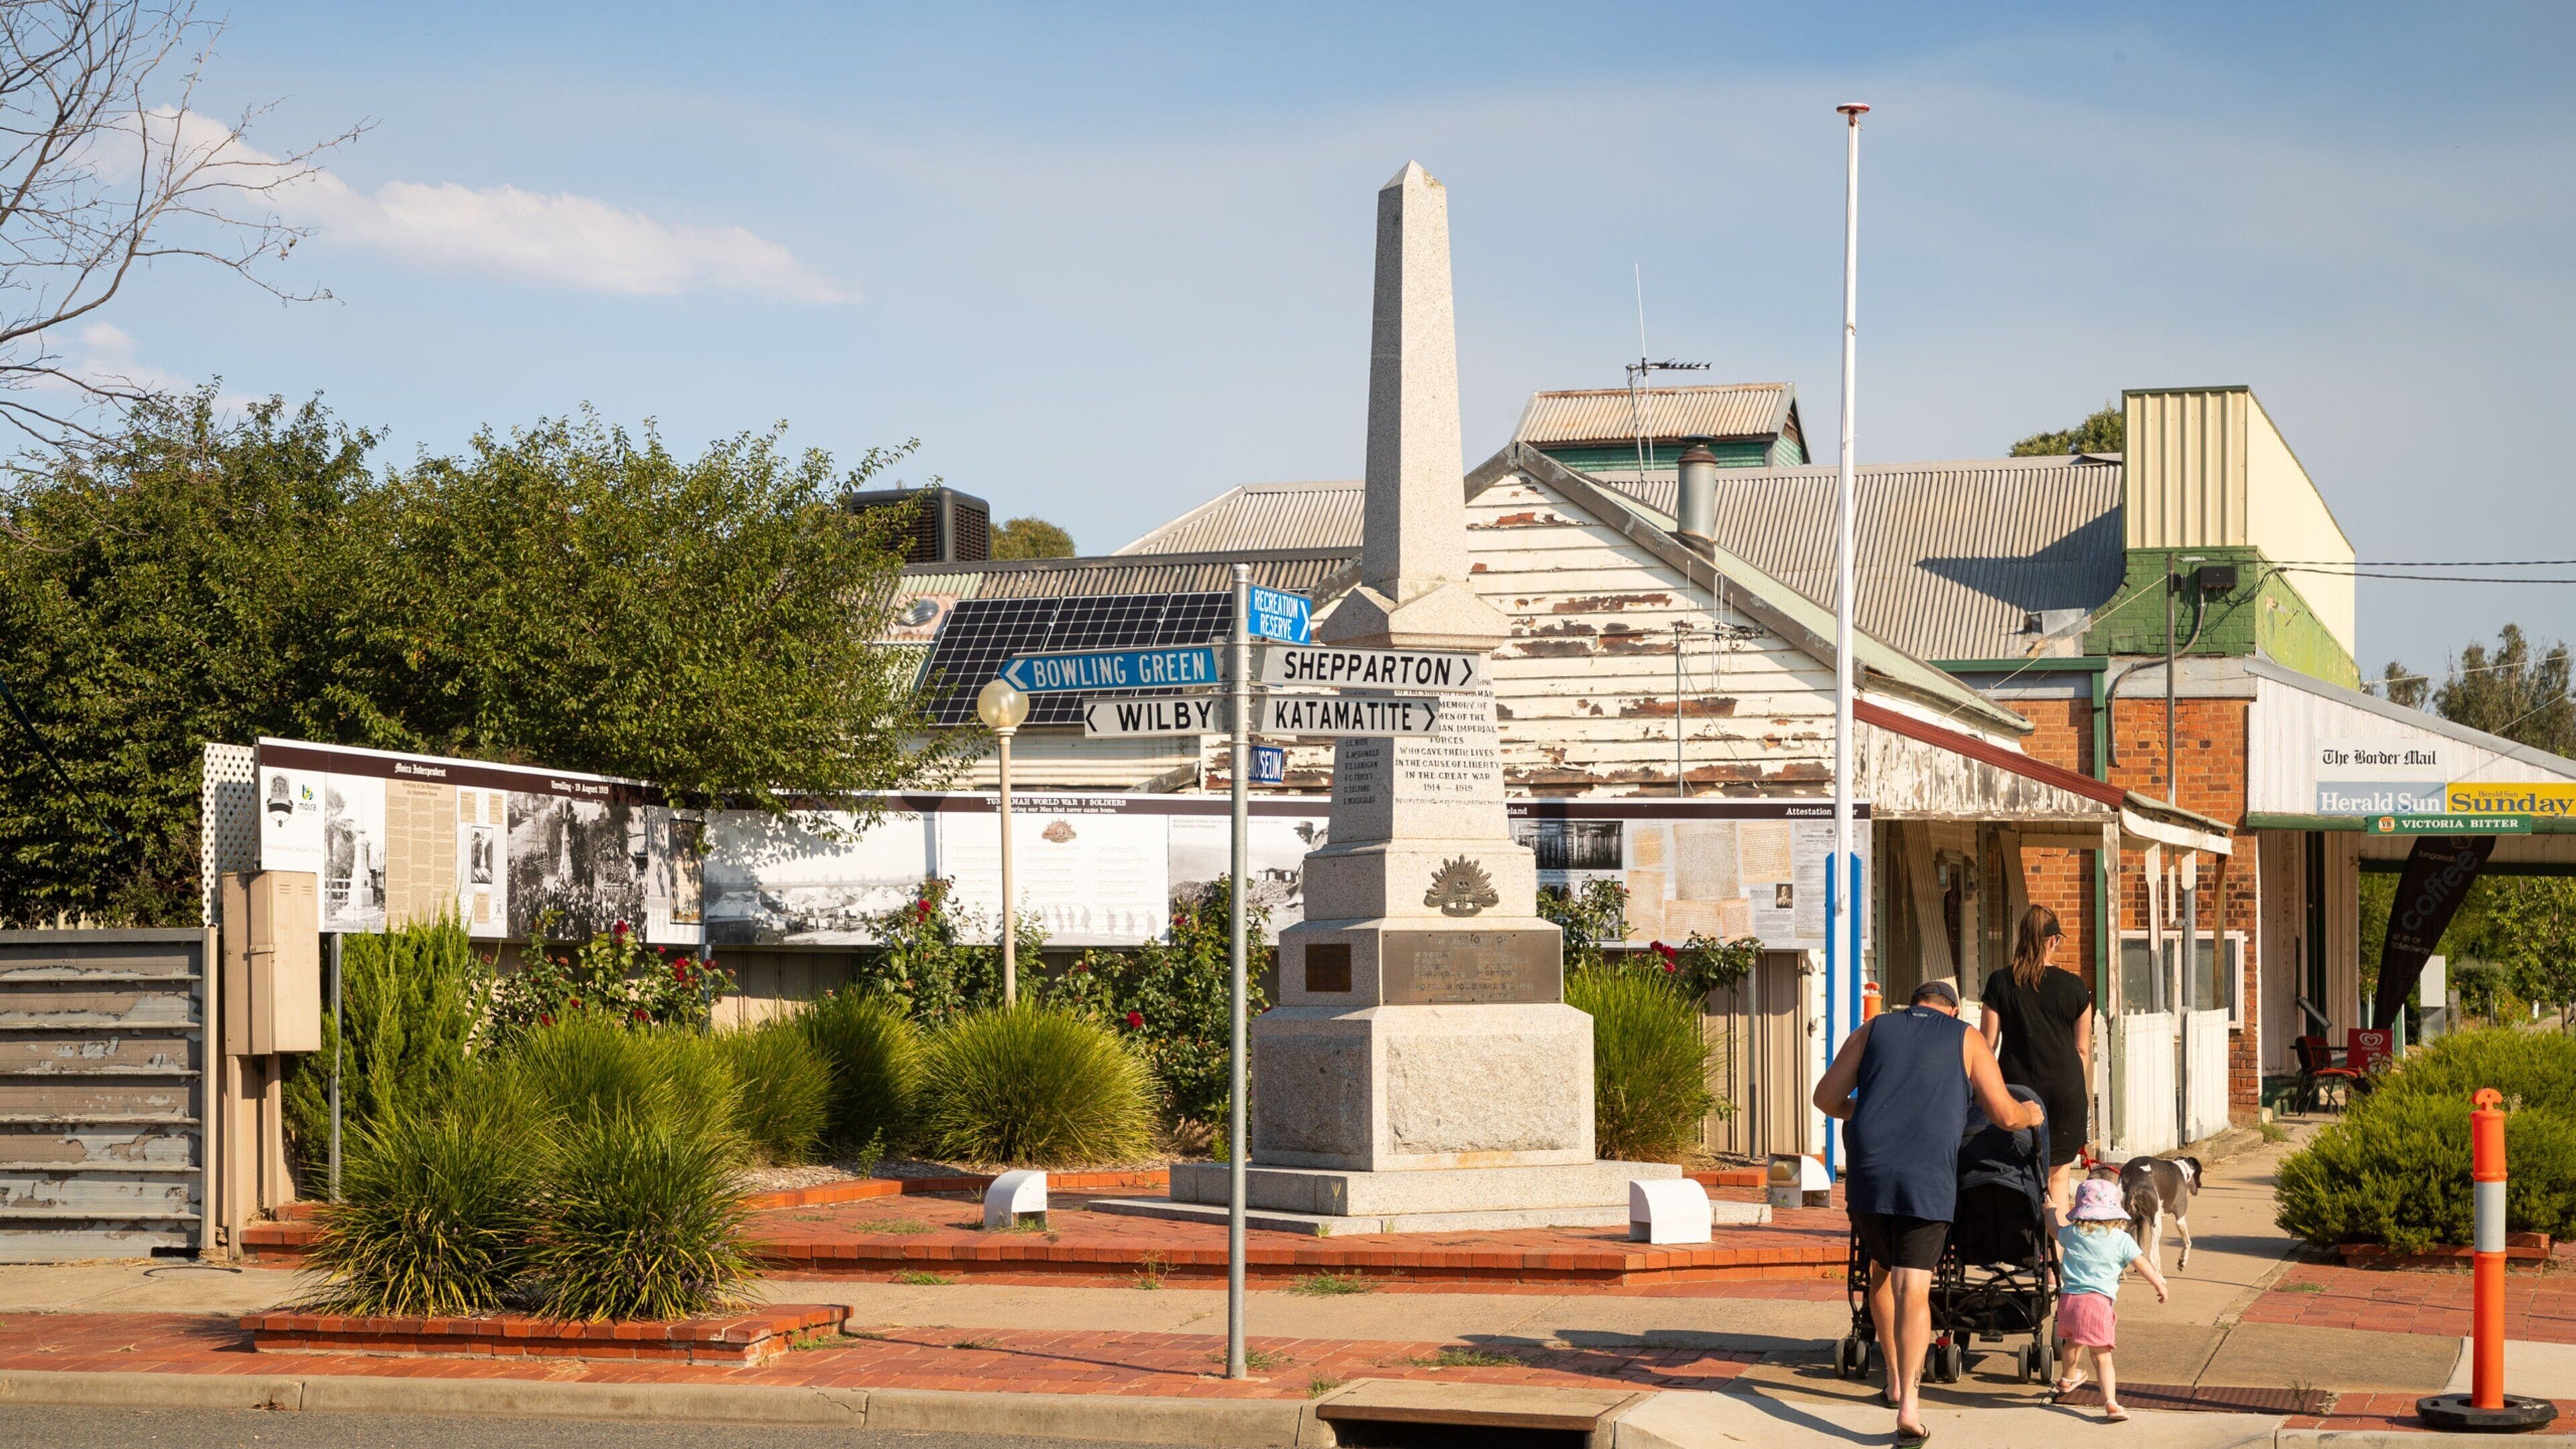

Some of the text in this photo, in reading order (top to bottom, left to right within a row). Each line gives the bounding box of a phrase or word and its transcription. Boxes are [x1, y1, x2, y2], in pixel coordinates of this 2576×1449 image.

[1254, 589, 1298, 619] RECREATION
[1260, 612, 1293, 640] RESERVE
[1034, 651, 1206, 688] BOWLING GREEN
[1284, 651, 1451, 686] SHEPPARTON
[1439, 701, 1474, 709] MEMORY
[1117, 700, 1212, 731] WILBY
[1275, 700, 1413, 731] KATAMATITE
[1457, 725, 1497, 733] IMPERIAL
[1444, 748, 1468, 756] THEIR
[1470, 749, 1494, 757] LIVES
[2322, 749, 2437, 766] The Border Mail
[394, 762, 412, 773] Moira
[1250, 750, 1281, 779] MUSEUM
[1463, 761, 1500, 769] LIBERTY
[1438, 772, 1468, 780] GREAT
[551, 780, 572, 792] Unveiling
[582, 784, 598, 794] August
[1455, 784, 1473, 792] 1919
[299, 802, 317, 812] moira
[986, 798, 1030, 806] TUNMAH
[2320, 791, 2442, 813] Herald Sun
[2451, 792, 2575, 818] Sunday
[1786, 807, 1832, 816] Attestation
[2381, 819, 2518, 828] VB VICTORIA BITTER
[2402, 851, 2478, 931] coffee
[2391, 941, 2431, 955] takeaway
